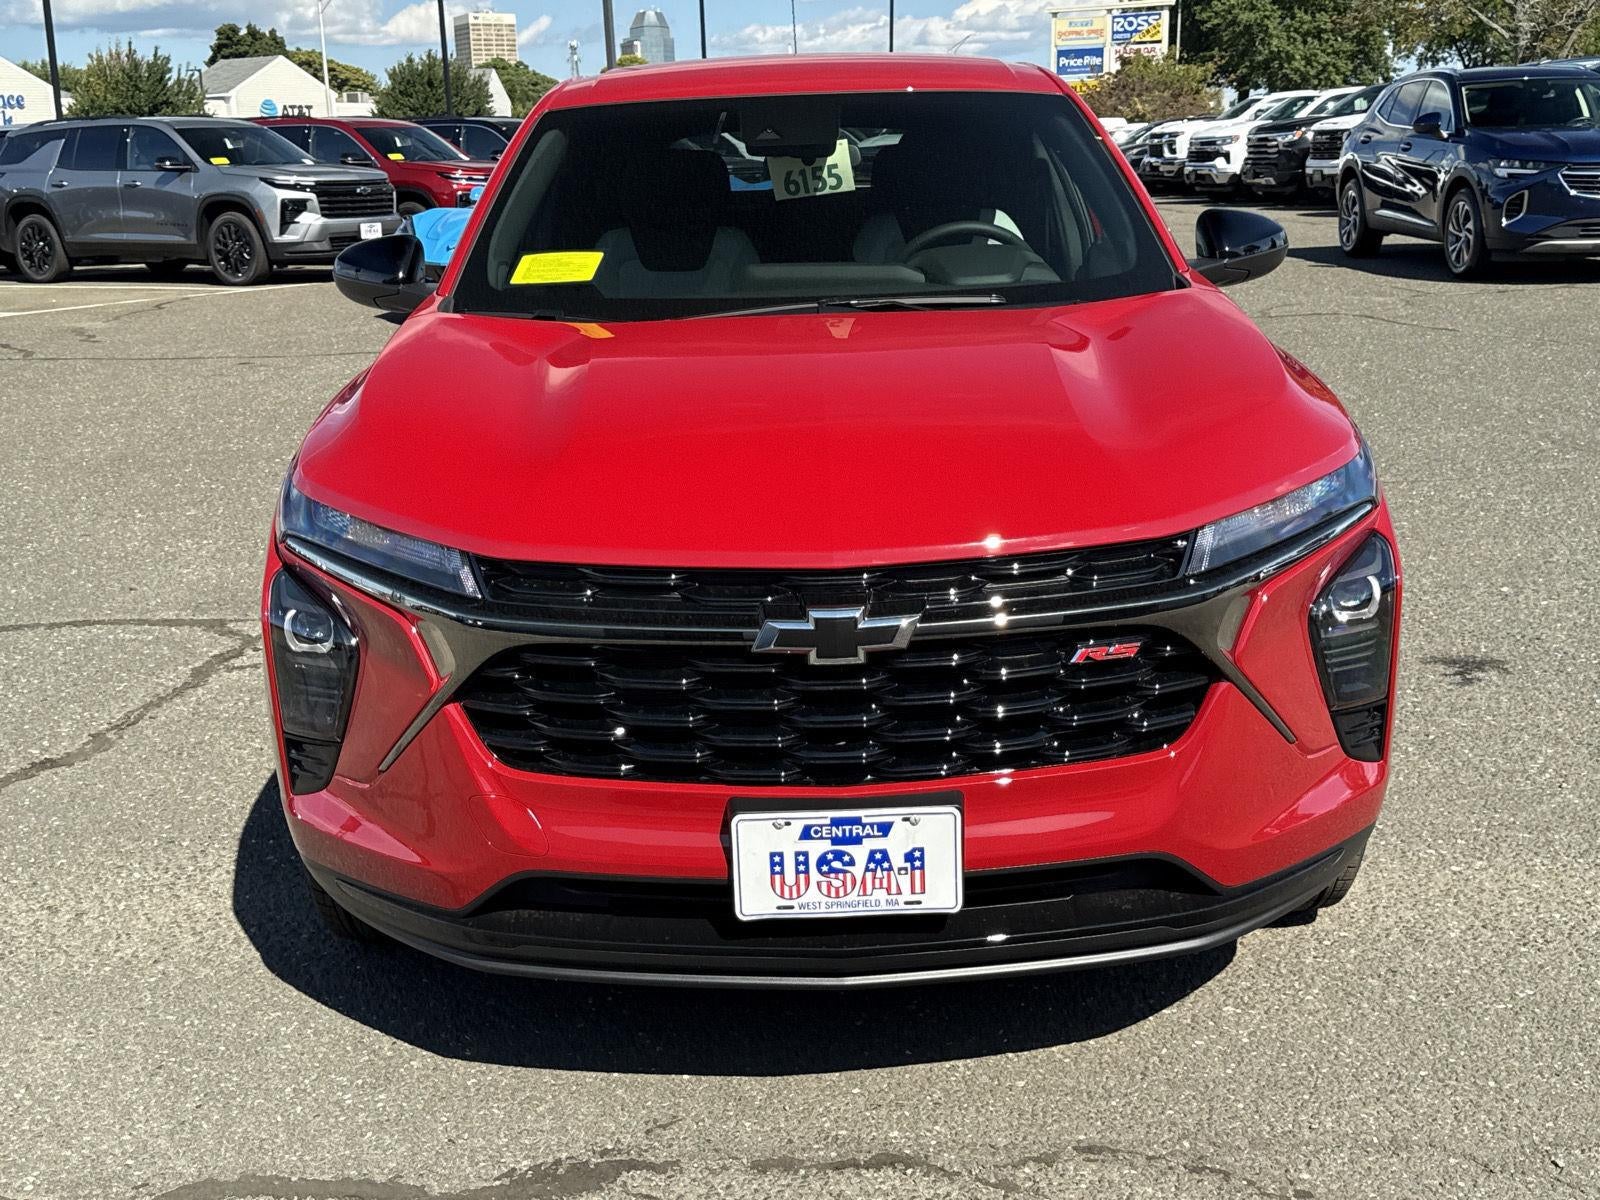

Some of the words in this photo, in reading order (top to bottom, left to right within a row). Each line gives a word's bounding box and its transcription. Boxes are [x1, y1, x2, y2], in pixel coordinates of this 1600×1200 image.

[1113, 15, 1160, 32] ROSS
[1059, 56, 1083, 67] Price
[1083, 55, 1102, 66] Rite
[282, 104, 313, 118] AT&T
[783, 163, 843, 196] 6155
[1069, 642, 1141, 664] RS
[810, 824, 883, 840] CENTRAL
[769, 847, 926, 900] USA-1
[798, 902, 822, 911] WEST
[824, 899, 883, 910] SPRINGFIELD,
[886, 899, 900, 908] MA
